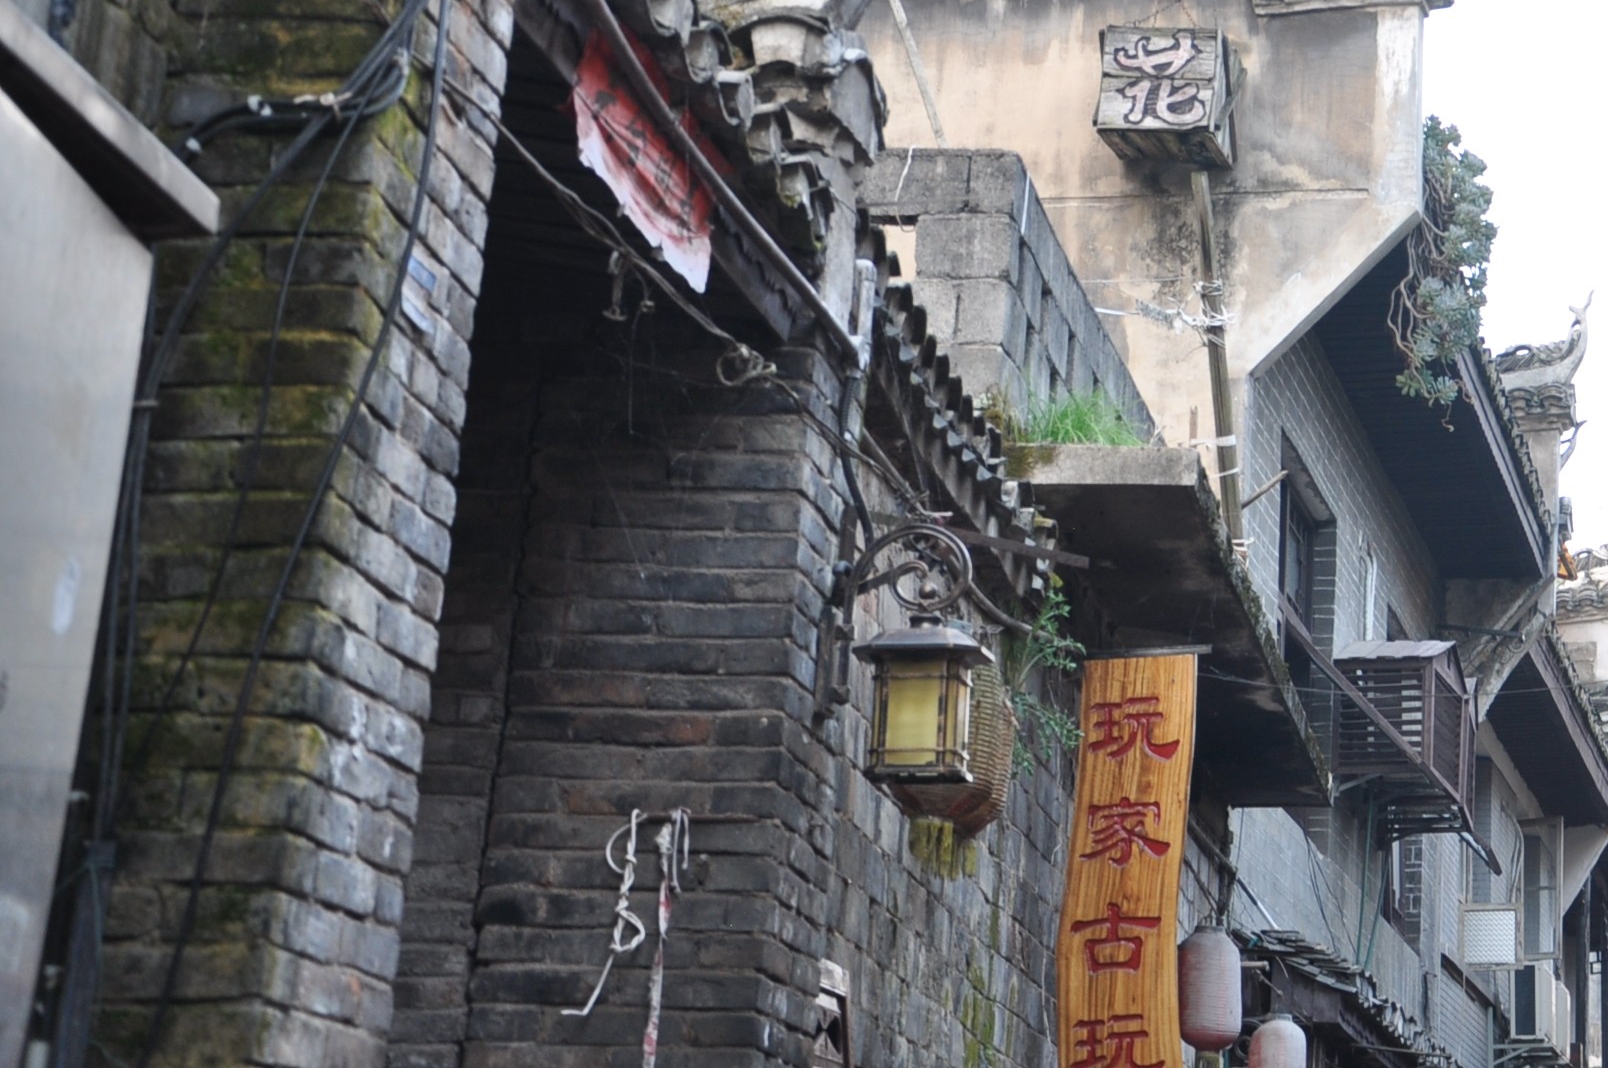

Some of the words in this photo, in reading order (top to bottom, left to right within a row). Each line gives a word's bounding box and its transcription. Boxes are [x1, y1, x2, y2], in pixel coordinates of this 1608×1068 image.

[1113, 29, 1206, 126] 花
[1069, 695, 1181, 1068] 玩家古玩
